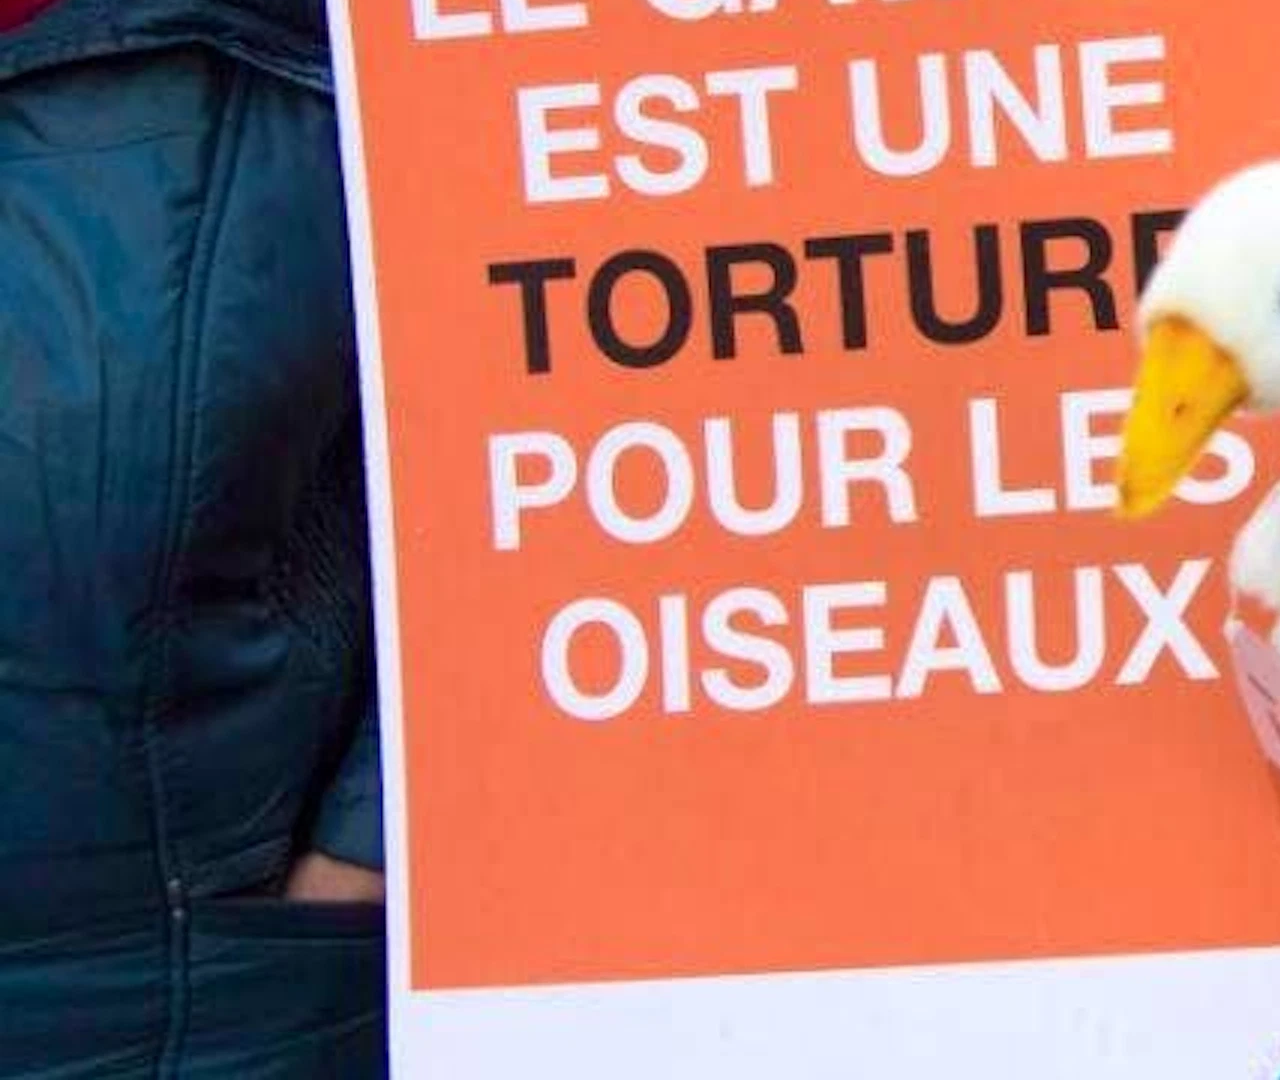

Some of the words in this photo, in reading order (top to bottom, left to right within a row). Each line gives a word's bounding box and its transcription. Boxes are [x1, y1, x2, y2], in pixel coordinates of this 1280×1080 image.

[516, 65, 799, 204] EST
[848, 34, 1174, 177] UNE
[487, 406, 917, 551] POUR
[540, 559, 1219, 721] OISEAUX
